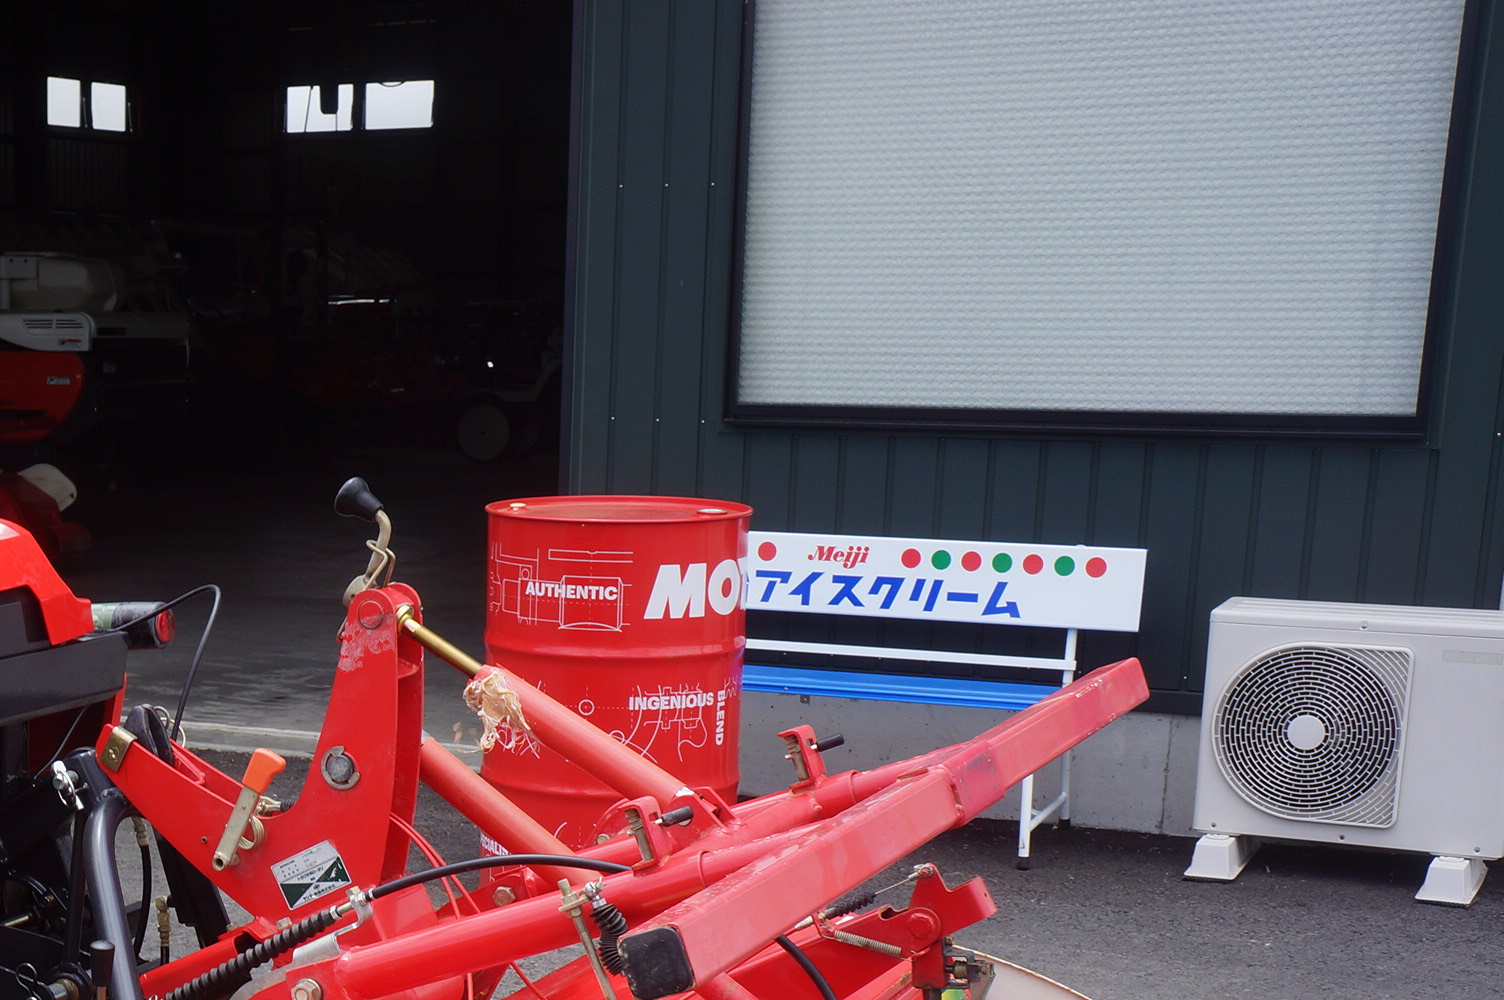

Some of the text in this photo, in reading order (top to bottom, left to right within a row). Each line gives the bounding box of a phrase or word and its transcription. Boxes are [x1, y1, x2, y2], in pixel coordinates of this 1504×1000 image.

[808, 545, 871, 568] Meiji
[525, 581, 618, 601] AUTHENTIC
[746, 569, 1021, 618] アイスクリーム
[628, 692, 714, 711] INGENIOUS
[715, 690, 726, 746] BLEND
